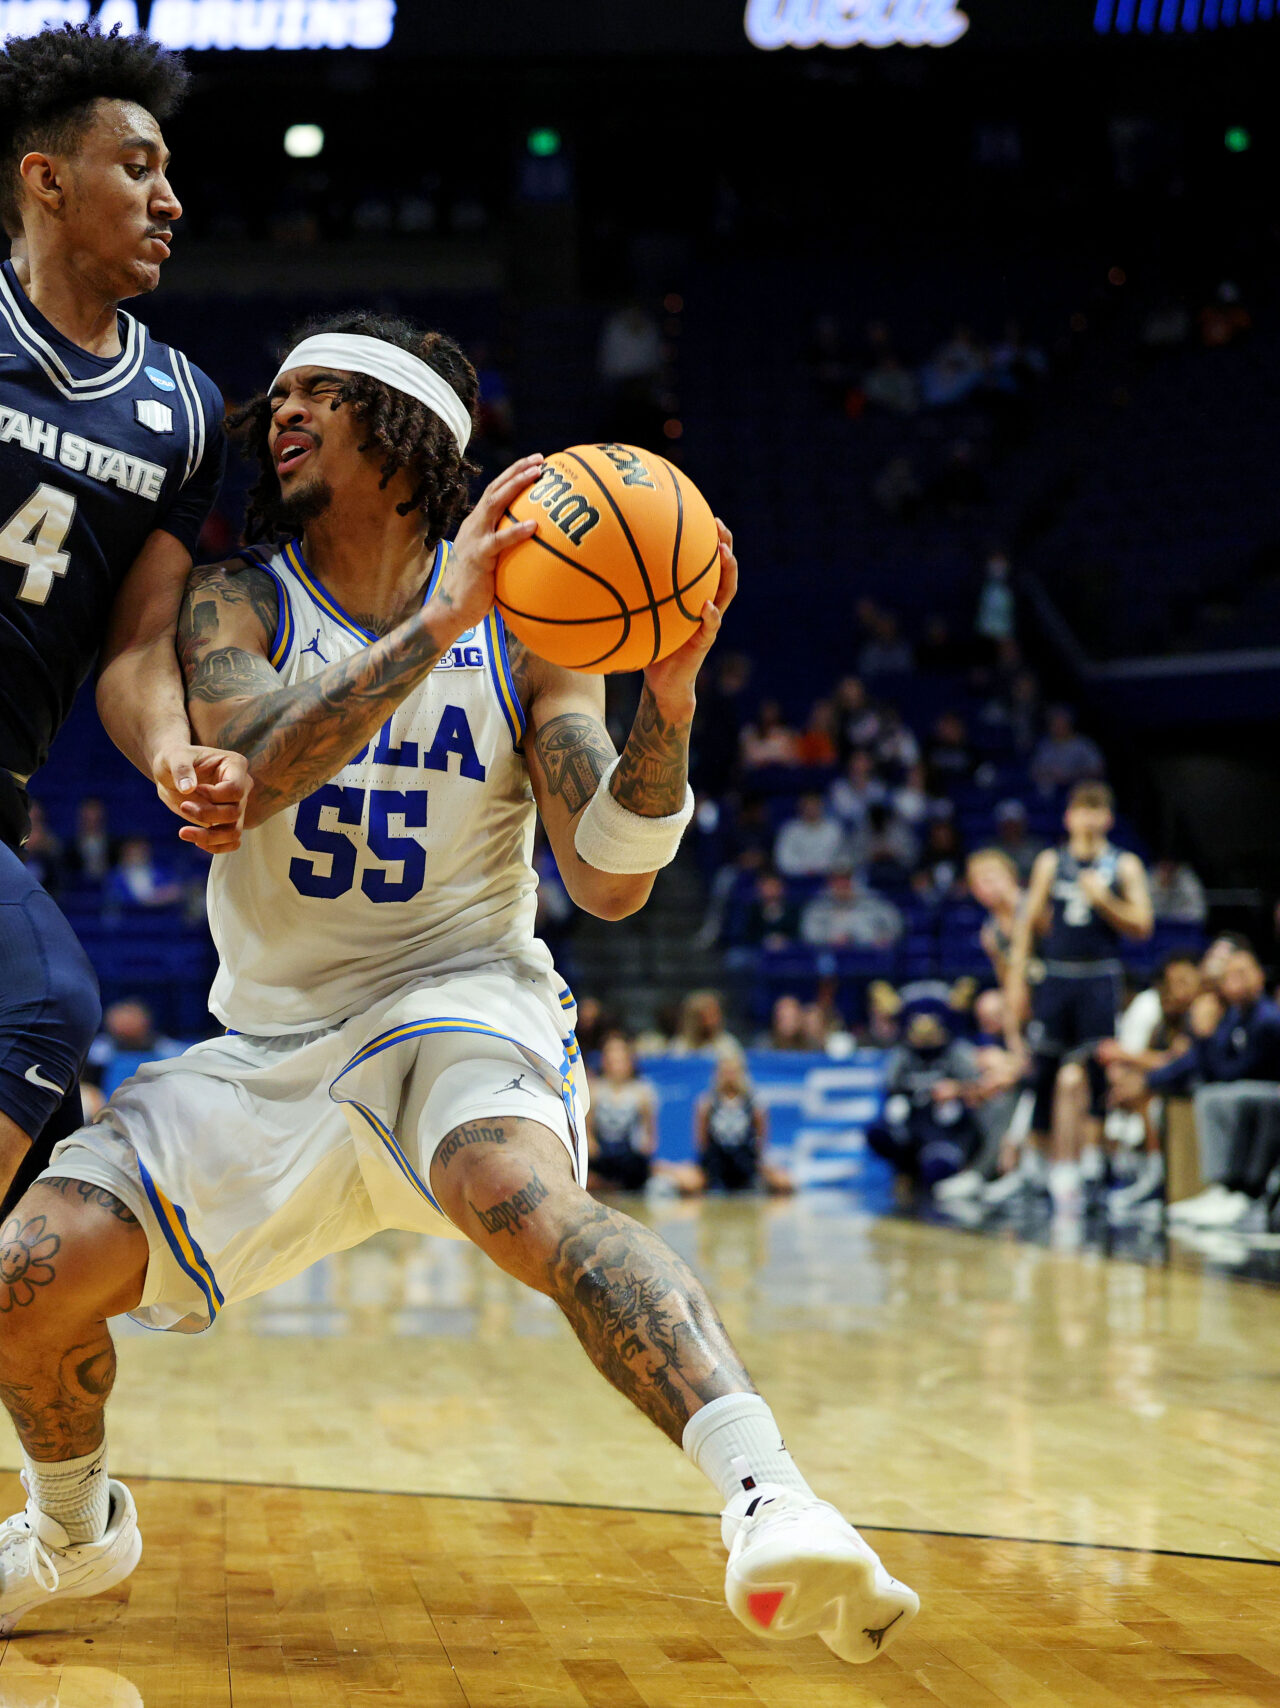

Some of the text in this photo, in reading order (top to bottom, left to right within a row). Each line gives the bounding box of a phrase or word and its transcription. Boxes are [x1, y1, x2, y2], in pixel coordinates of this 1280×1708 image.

[59, 432, 167, 502] STATE
[288, 783, 429, 904] 55
[439, 1122, 508, 1169] nothing
[468, 1165, 550, 1236] happened
